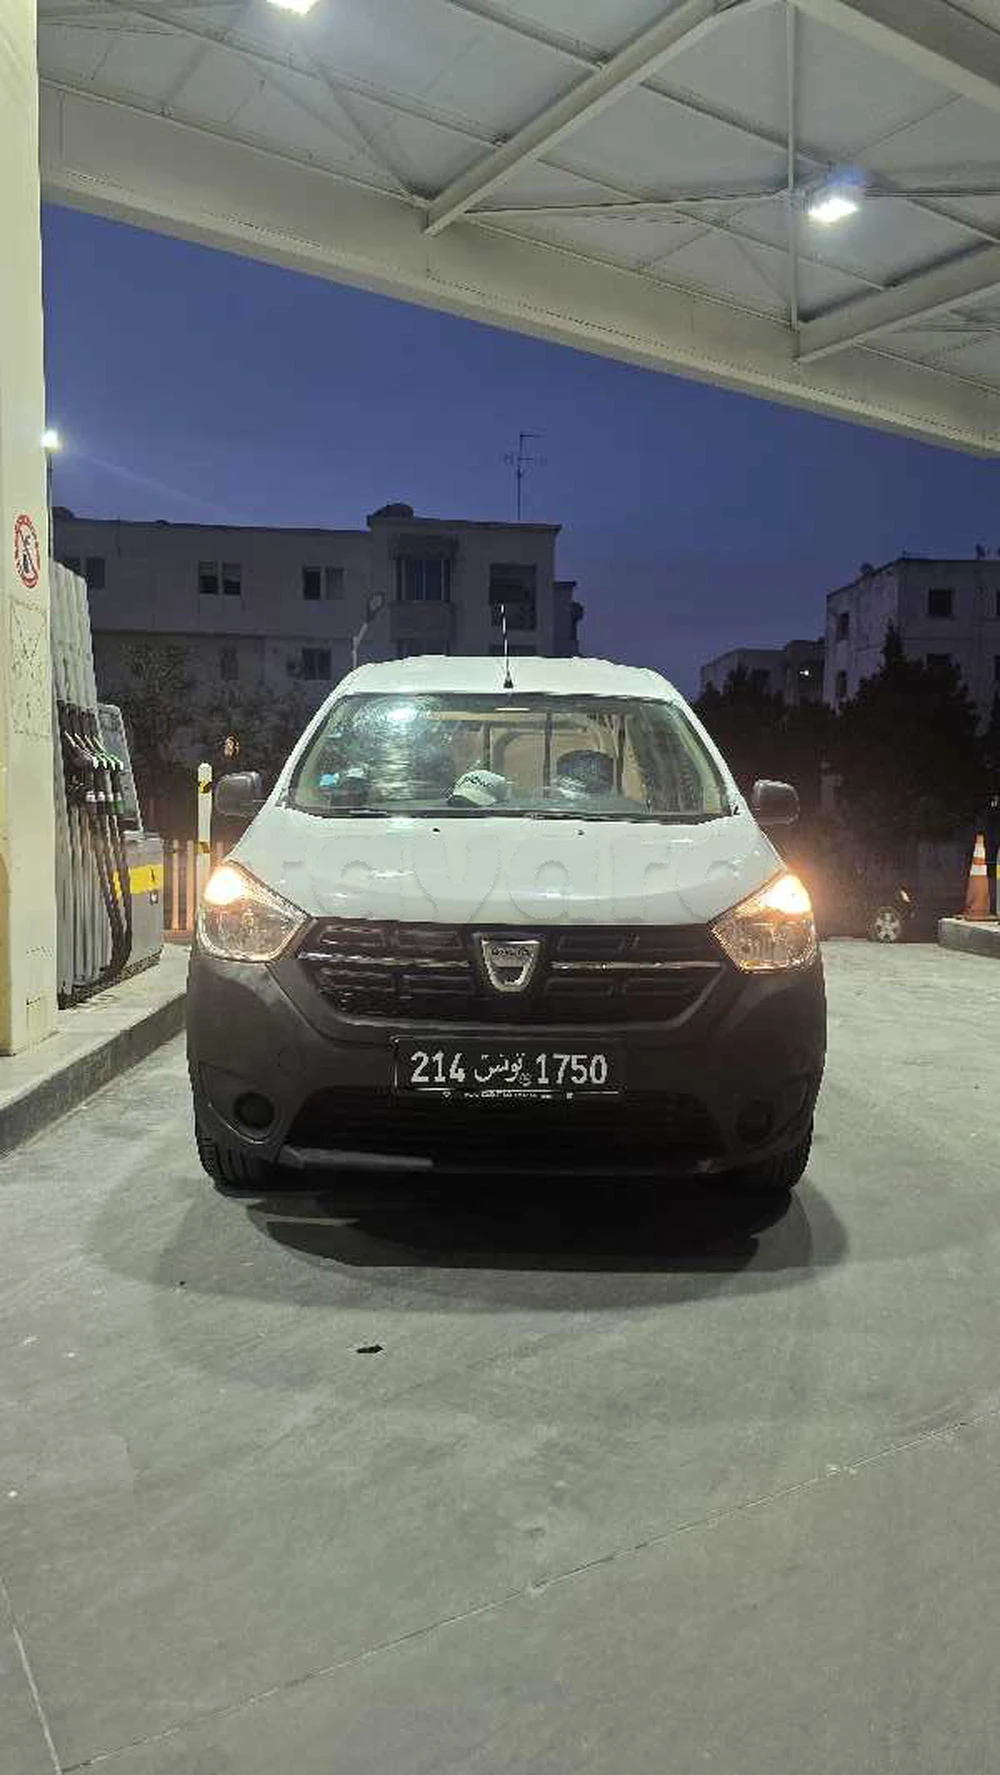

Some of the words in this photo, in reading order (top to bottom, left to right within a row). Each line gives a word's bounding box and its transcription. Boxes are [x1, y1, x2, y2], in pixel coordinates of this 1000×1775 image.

[410, 1050, 466, 1083] 214
[473, 1052, 526, 1082] تونس
[535, 1052, 608, 1084] 1750
